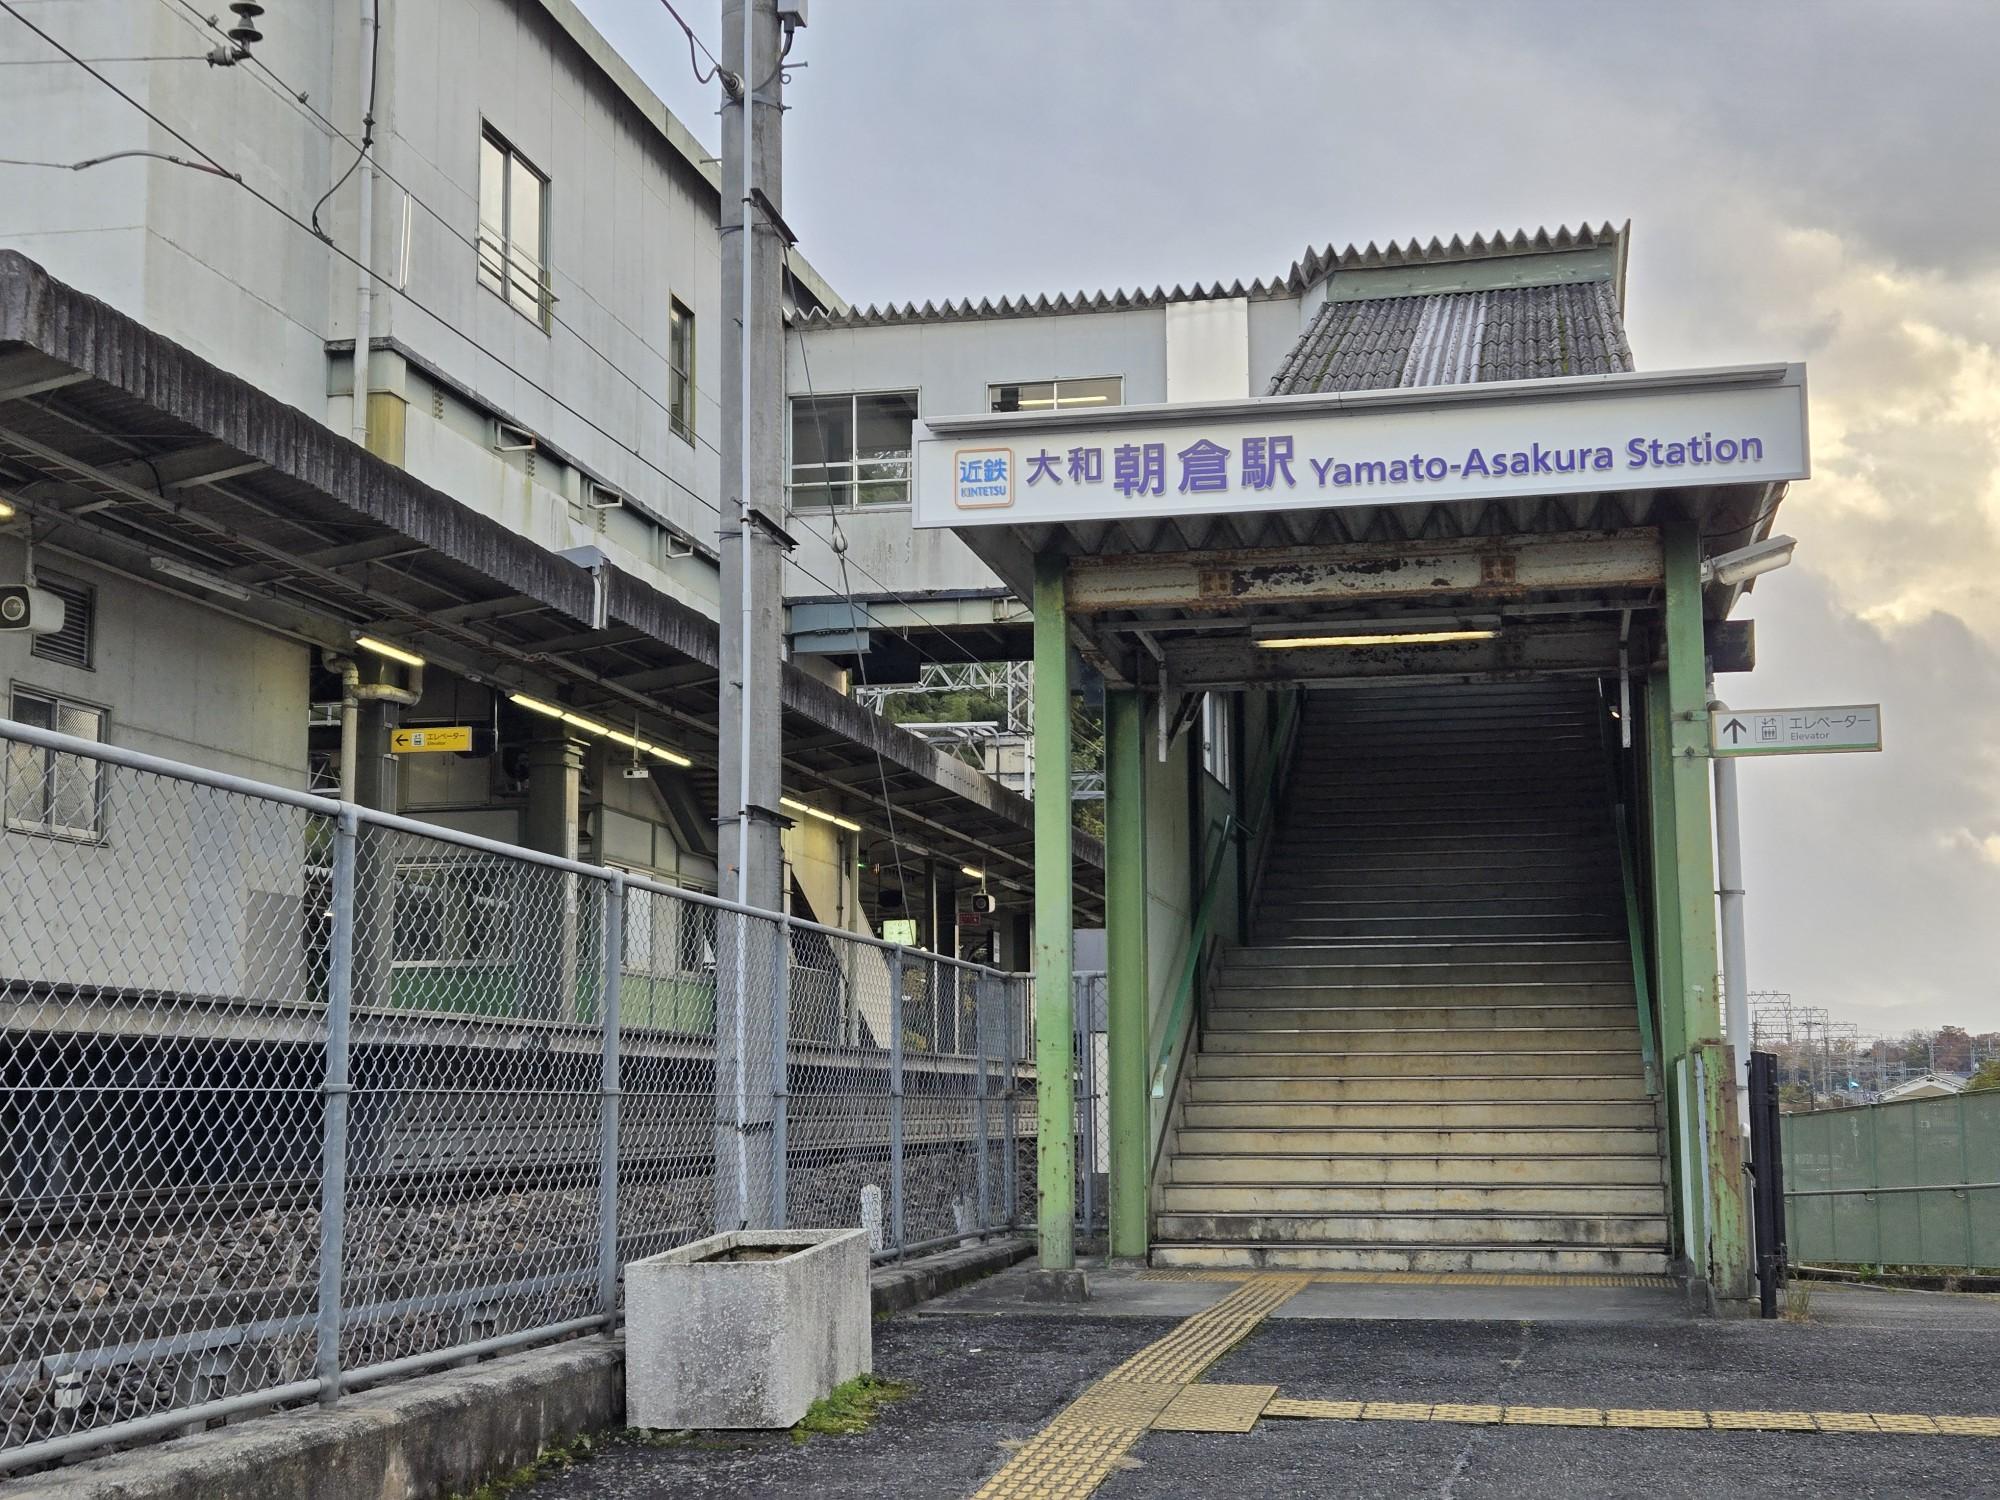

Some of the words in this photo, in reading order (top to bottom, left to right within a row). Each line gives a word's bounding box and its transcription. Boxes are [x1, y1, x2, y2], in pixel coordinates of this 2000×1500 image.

[1026, 435, 1297, 497] 大和朝倉駅
[1309, 442, 1613, 486] Yamato-Asakura
[1627, 432, 1763, 468] Station
[960, 458, 1007, 483] 近鉄
[961, 485, 1006, 498] KINTETSU
[1789, 715, 1871, 729] エレベーター
[1790, 731, 1830, 741] Elevator
